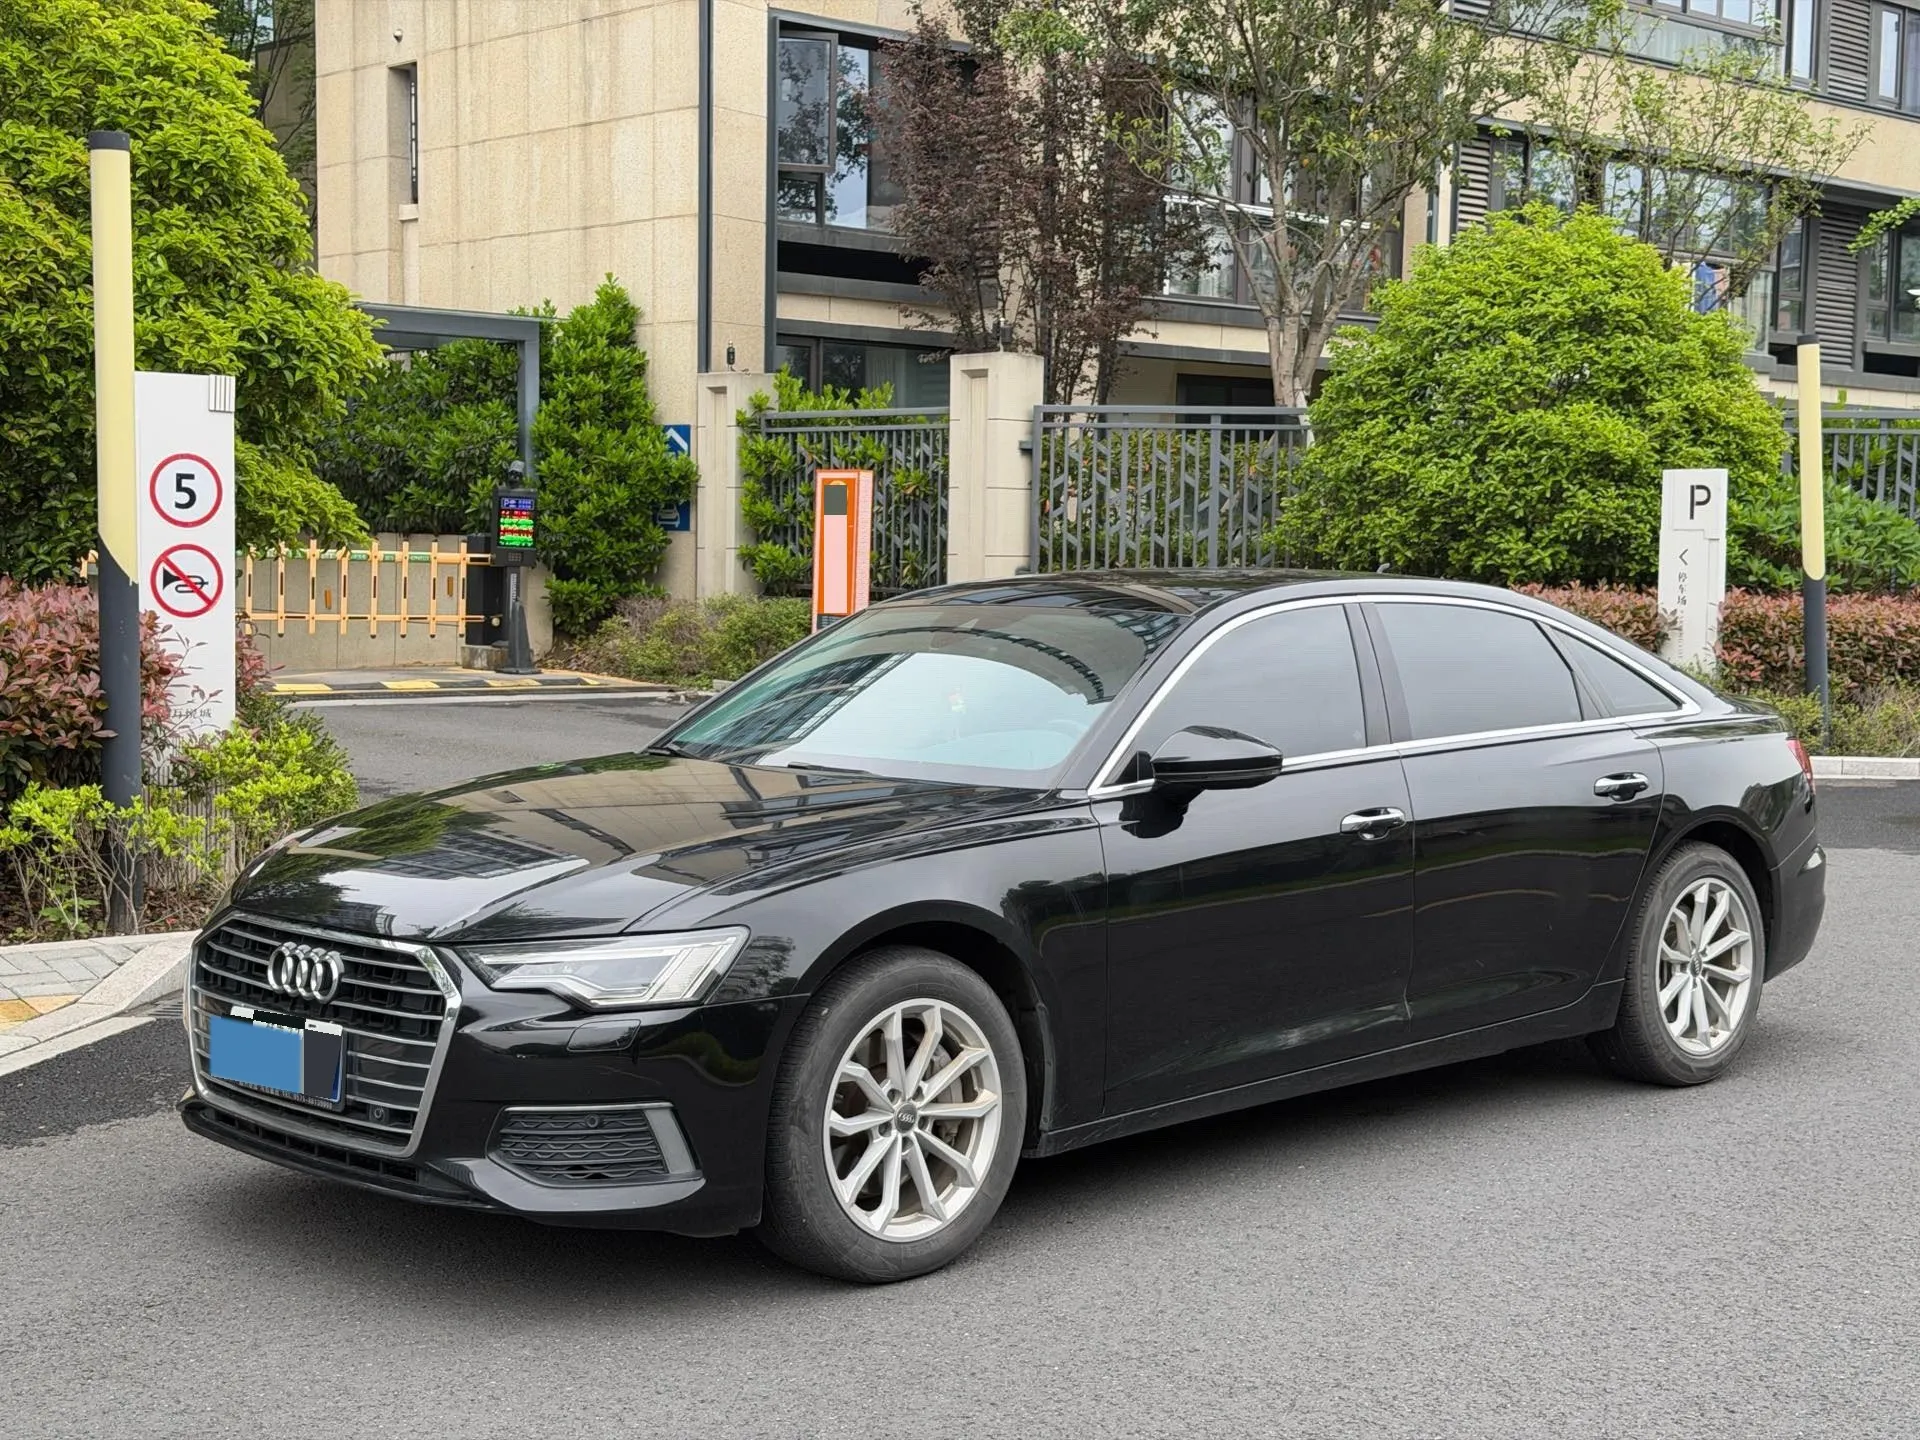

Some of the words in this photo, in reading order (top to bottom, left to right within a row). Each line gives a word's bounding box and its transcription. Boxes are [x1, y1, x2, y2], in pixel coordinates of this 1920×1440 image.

[174, 472, 197, 510] 5
[1689, 484, 1712, 520] P
[1677, 571, 1688, 606] 停车场
